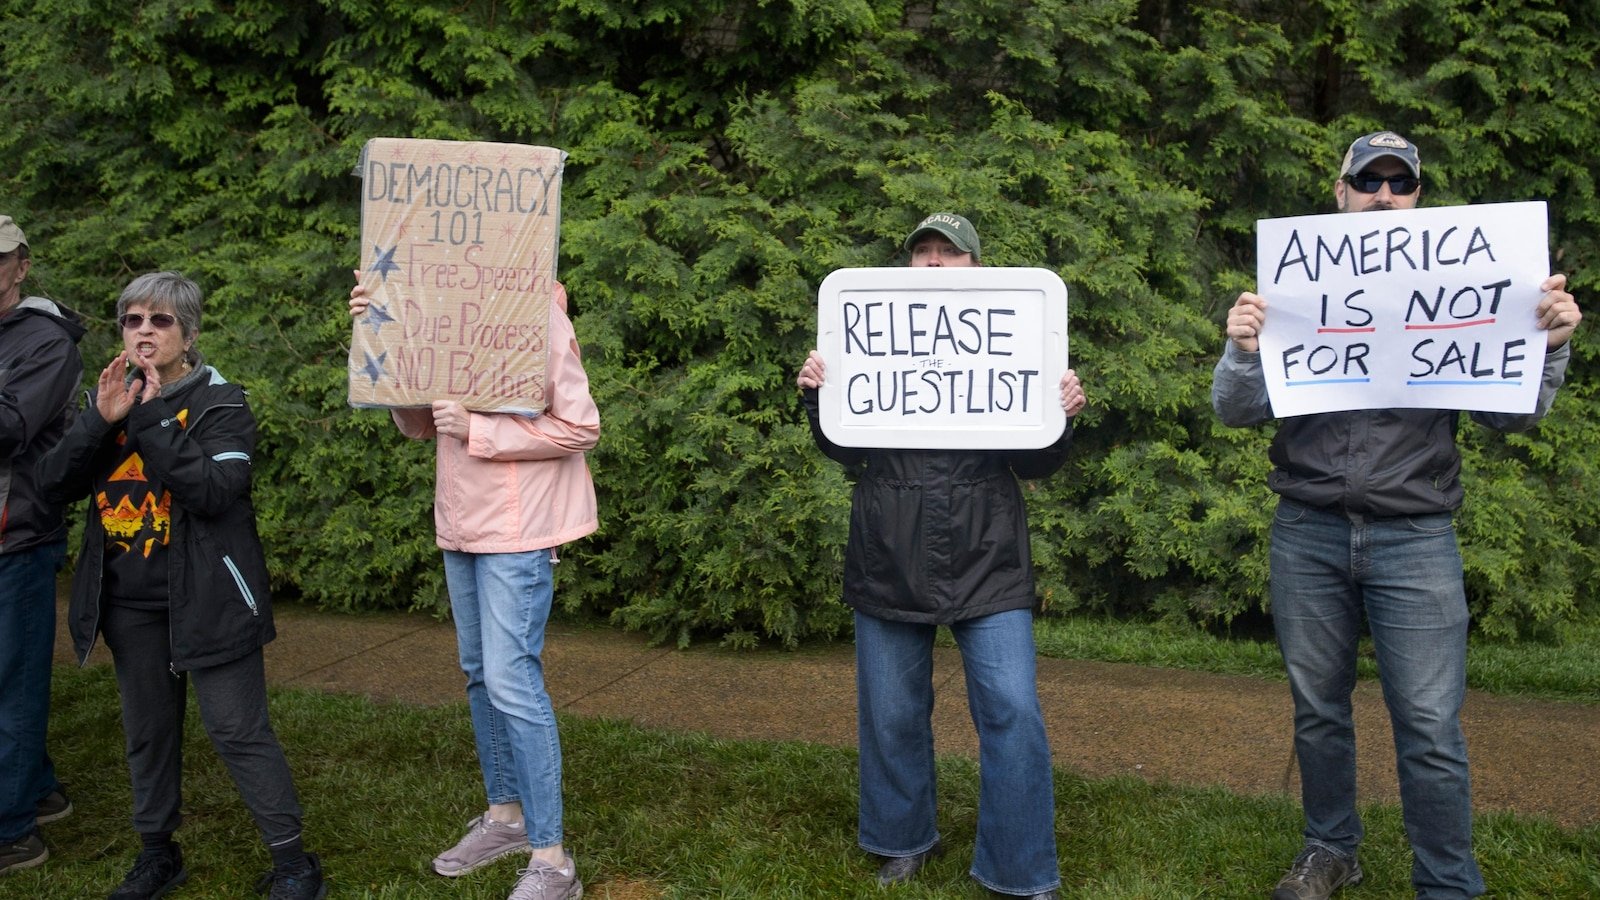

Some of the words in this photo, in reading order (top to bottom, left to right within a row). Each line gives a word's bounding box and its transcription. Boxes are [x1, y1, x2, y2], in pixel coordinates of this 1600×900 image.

[368, 160, 559, 216] DEMOCRACY
[428, 210, 485, 245] 101
[921, 214, 961, 229] ACADIA
[408, 243, 458, 288] Free
[460, 244, 548, 300] Speech
[1274, 226, 1496, 284] AMERICA
[402, 299, 451, 344] Due
[458, 301, 544, 352] Process
[843, 302, 1016, 357] RELEASE
[1320, 289, 1373, 327] IS
[1405, 278, 1512, 323] NOT
[395, 346, 435, 391] NO
[447, 350, 545, 401] Bribes
[1282, 342, 1370, 379] FOR
[1410, 338, 1526, 379] SALE
